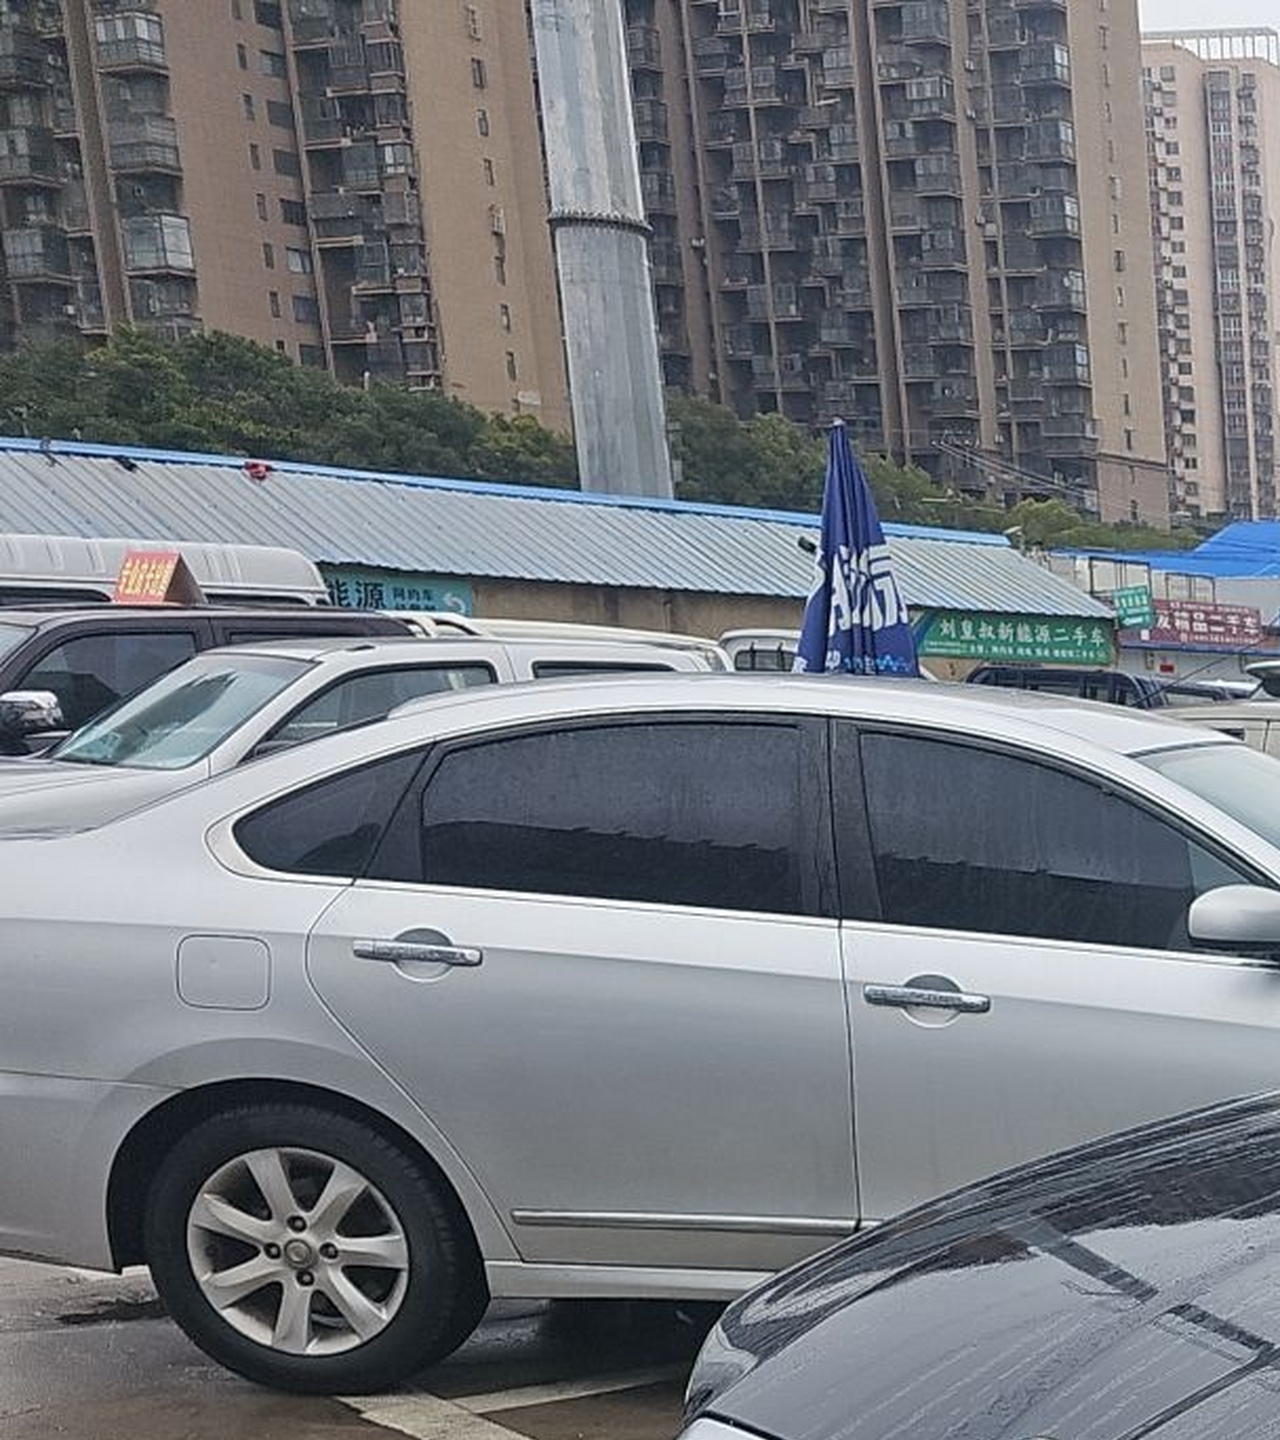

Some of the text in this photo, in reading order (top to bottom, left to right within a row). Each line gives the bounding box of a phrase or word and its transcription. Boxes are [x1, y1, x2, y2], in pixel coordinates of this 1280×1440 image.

[939, 618, 1106, 648] 刘皇叔新能源二手车
